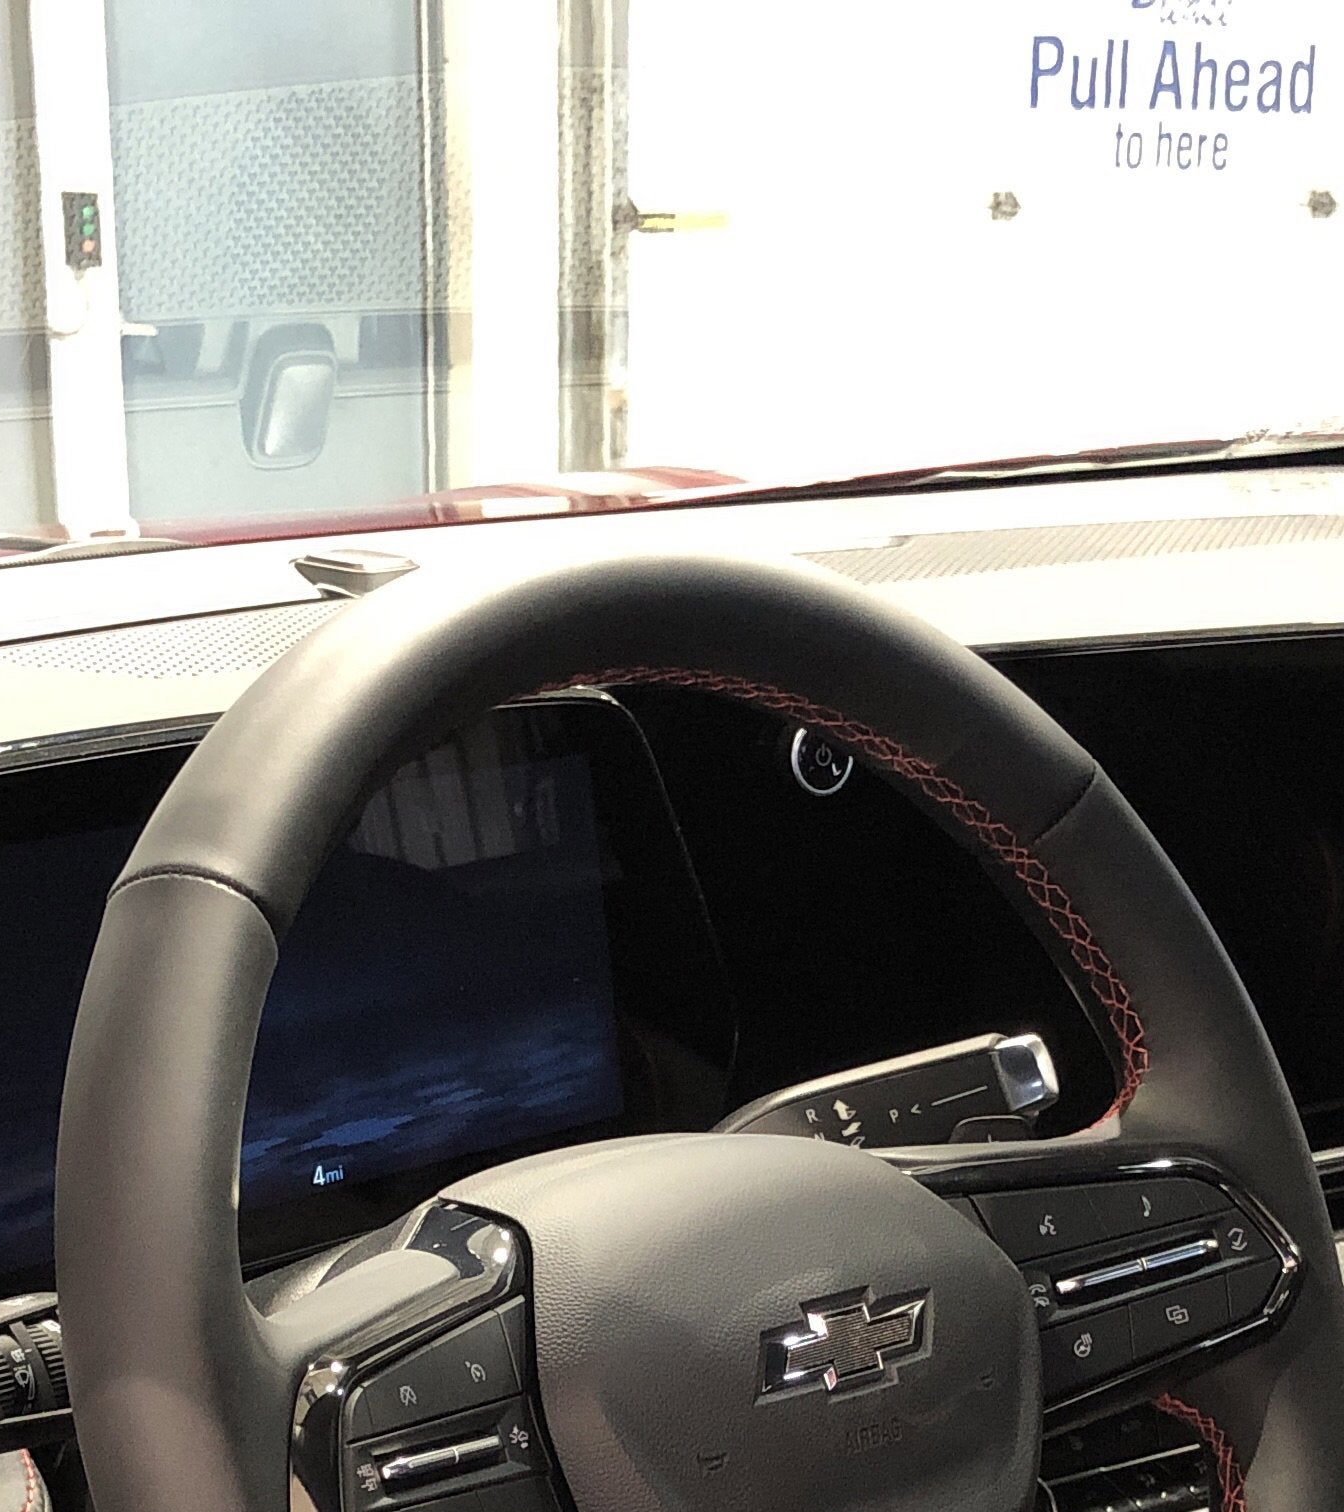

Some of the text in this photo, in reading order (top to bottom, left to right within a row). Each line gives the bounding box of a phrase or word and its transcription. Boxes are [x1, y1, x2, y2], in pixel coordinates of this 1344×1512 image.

[1029, 35, 1317, 114] Pull Ahead
[1114, 120, 1229, 171] to here
